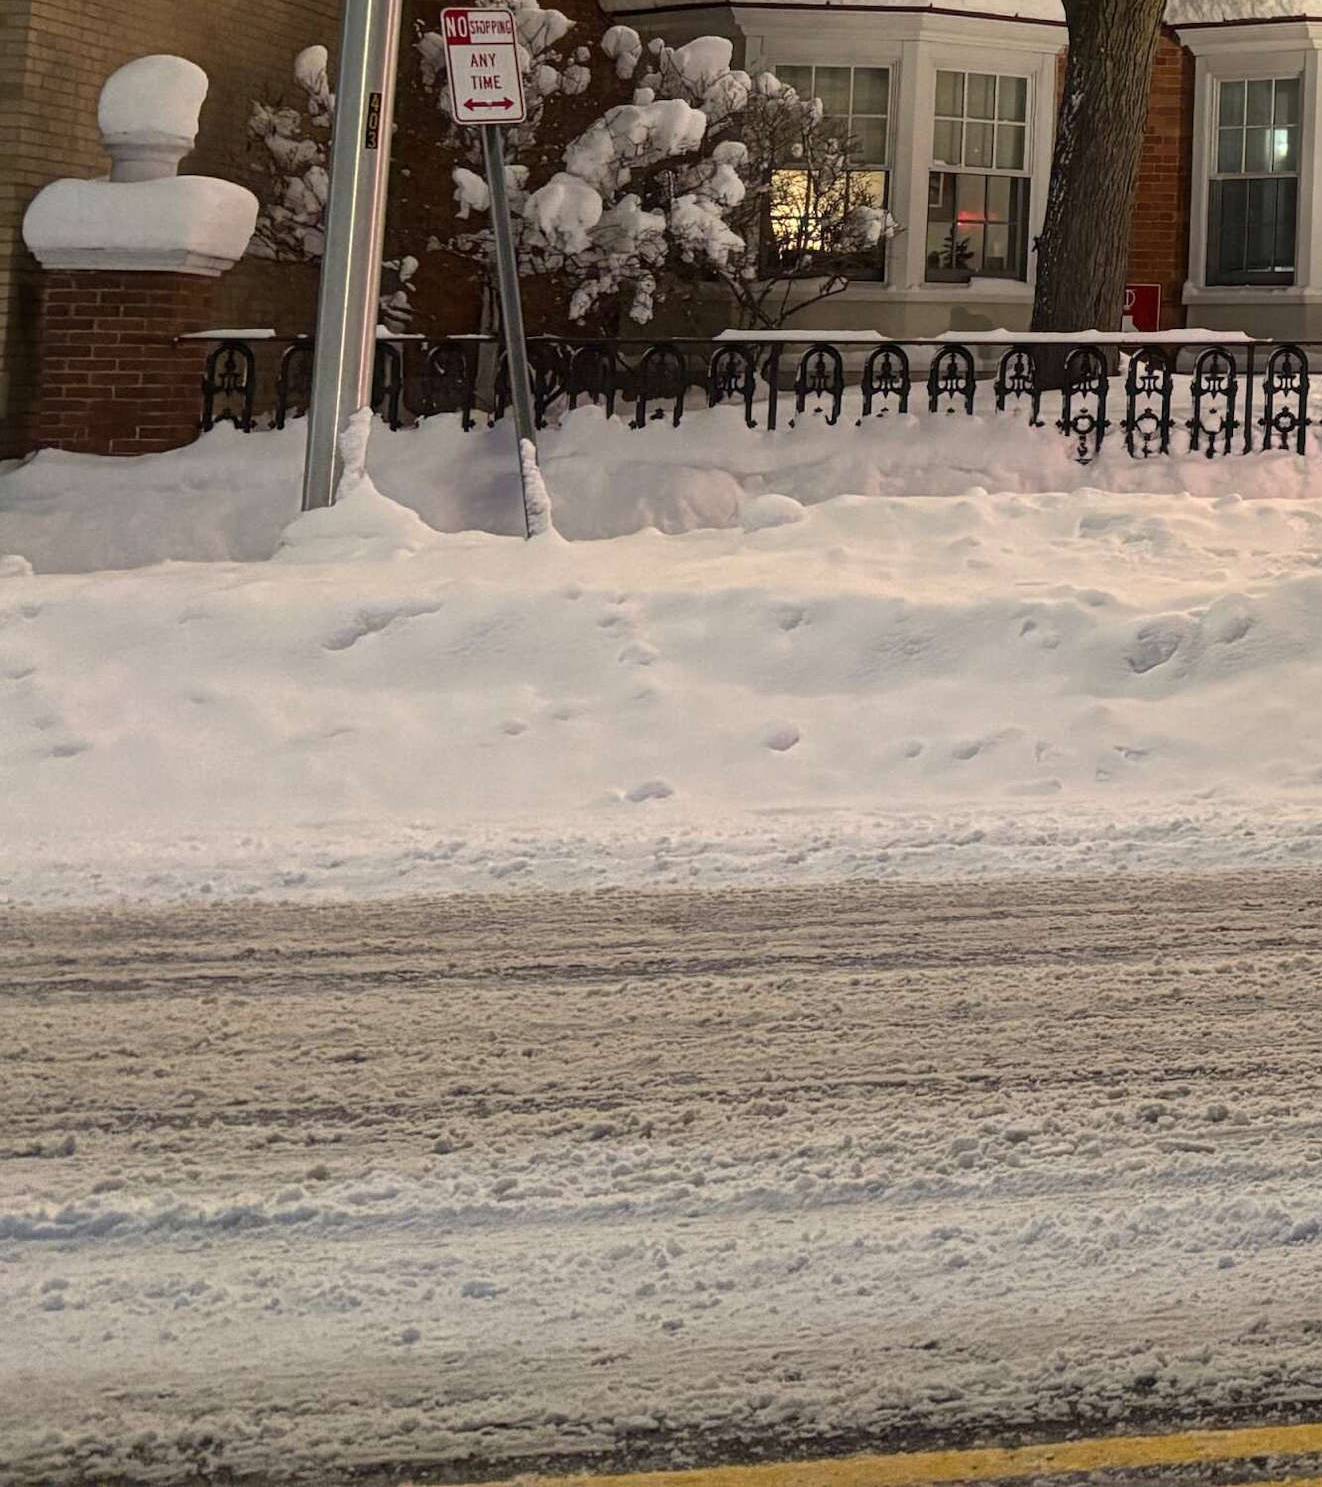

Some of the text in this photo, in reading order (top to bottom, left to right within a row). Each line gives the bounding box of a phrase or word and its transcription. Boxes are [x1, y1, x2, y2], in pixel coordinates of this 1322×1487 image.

[446, 16, 512, 38] NO STOPPING
[471, 53, 496, 67] ANY
[471, 75, 502, 90] TIME
[367, 94, 380, 148] 403
